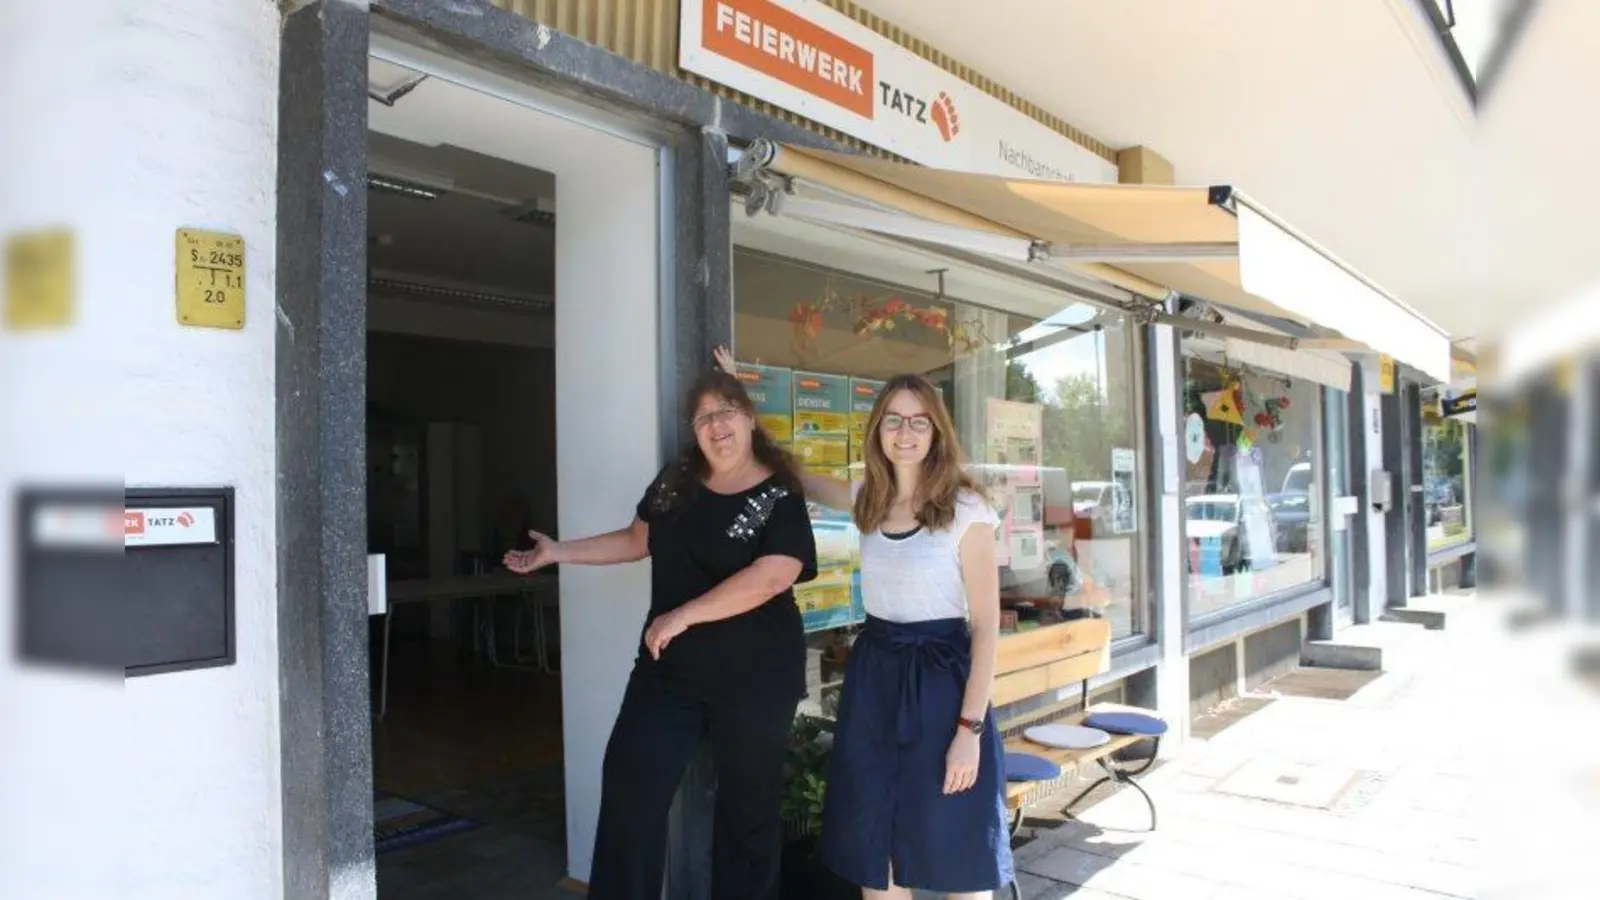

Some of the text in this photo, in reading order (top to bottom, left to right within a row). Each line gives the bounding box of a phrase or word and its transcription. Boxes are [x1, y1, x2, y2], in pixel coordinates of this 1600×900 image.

[716, 2, 928, 124] FEIERWERK TATZ
[210, 251, 243, 268] 2435
[148, 517, 175, 526] TATZ
